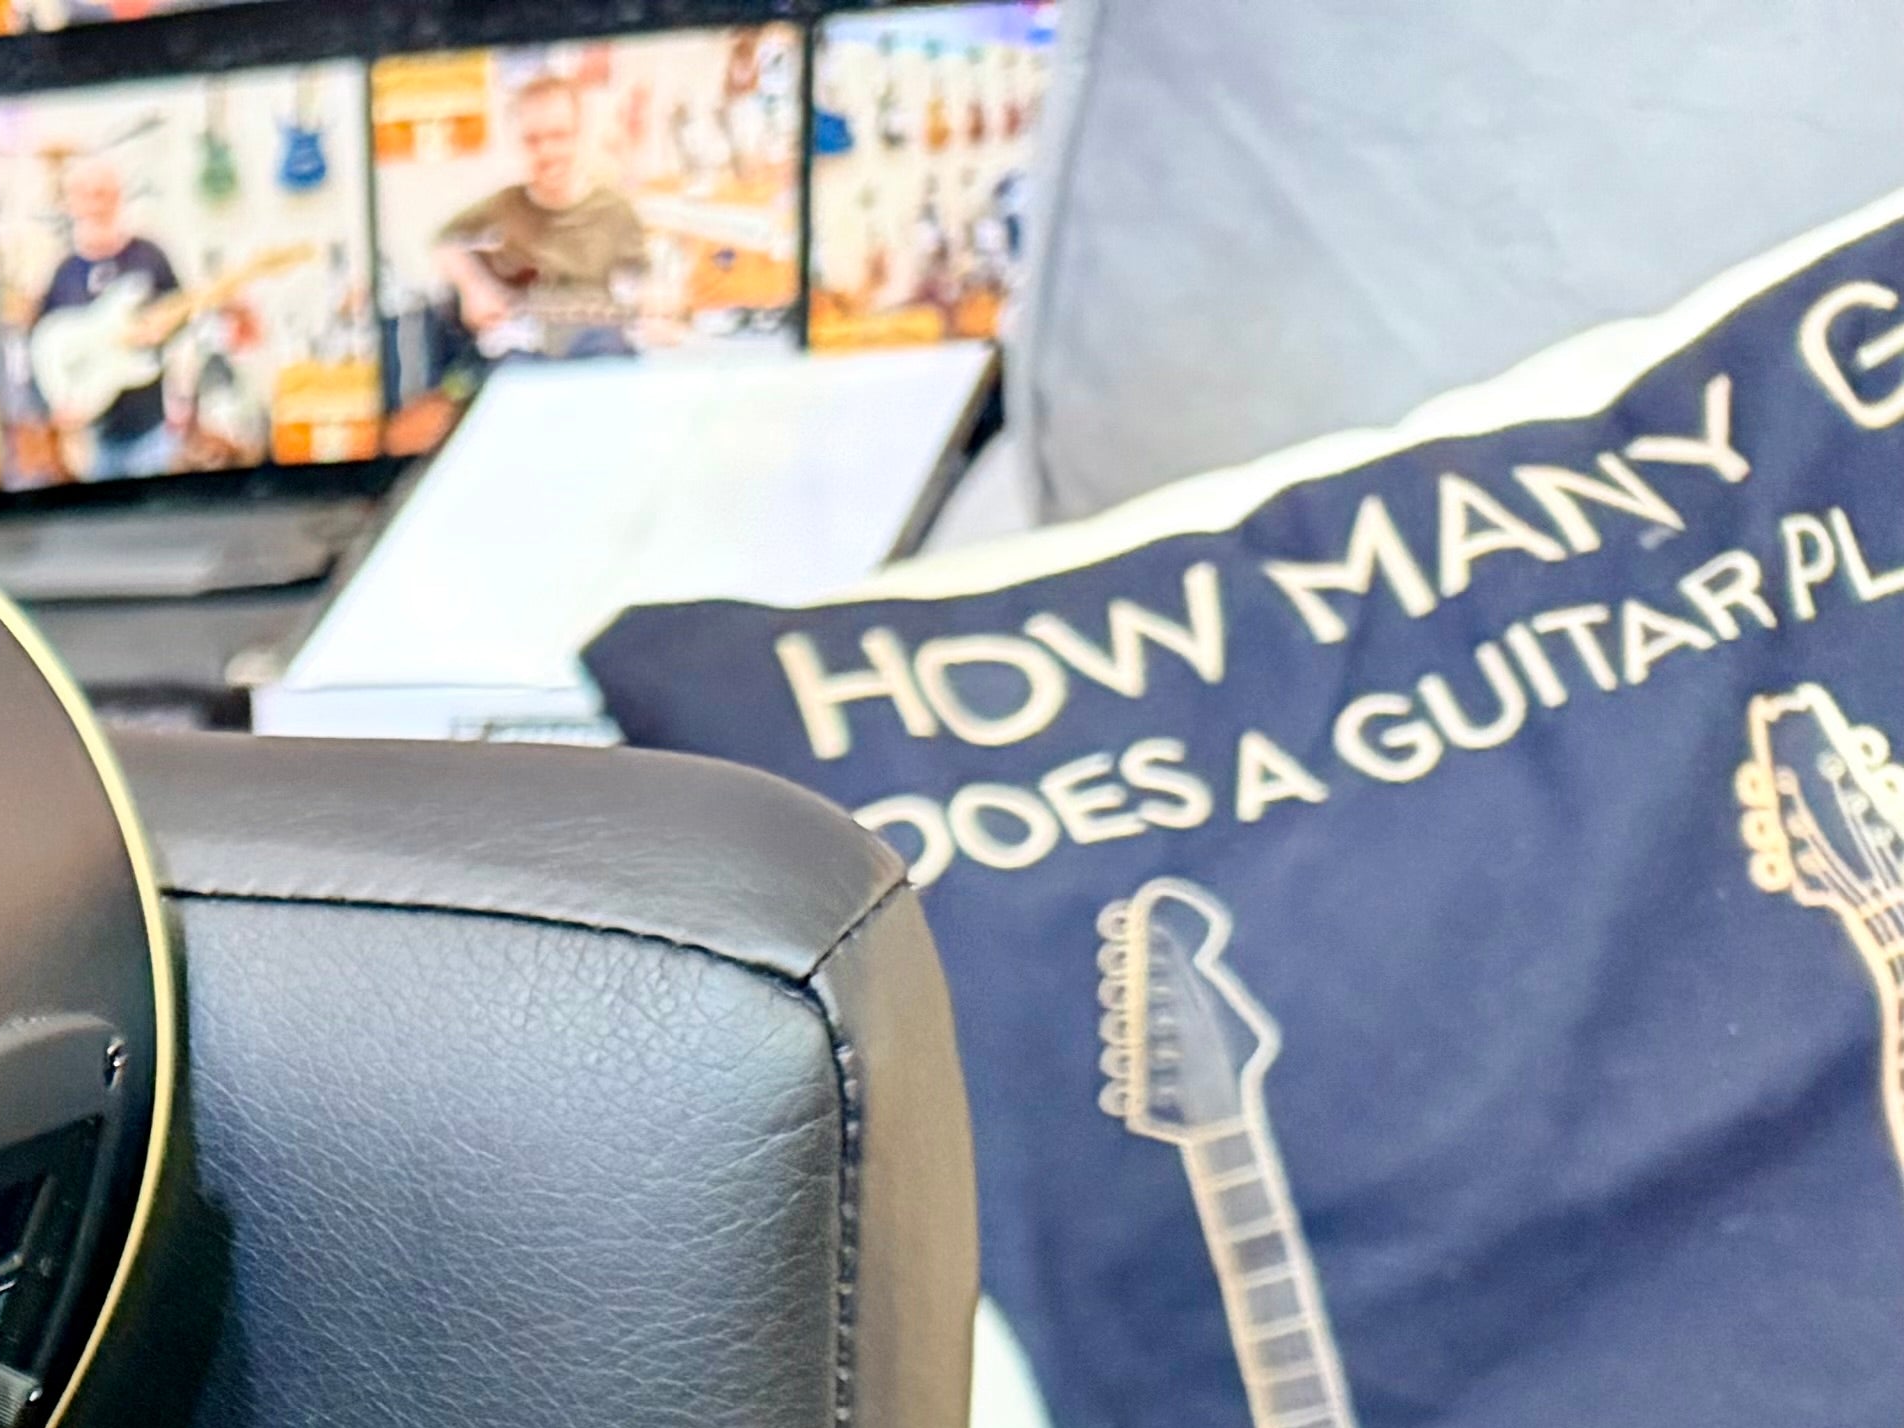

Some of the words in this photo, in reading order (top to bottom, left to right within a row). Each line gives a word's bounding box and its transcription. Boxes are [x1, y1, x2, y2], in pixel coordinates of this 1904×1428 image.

[775, 560, 1225, 760] HOW
[1260, 373, 1753, 645] MANY
[1798, 281, 1904, 430] G
[1235, 730, 1329, 823] A
[1332, 549, 1777, 783] GUITAR
[1780, 506, 1904, 621] PL
